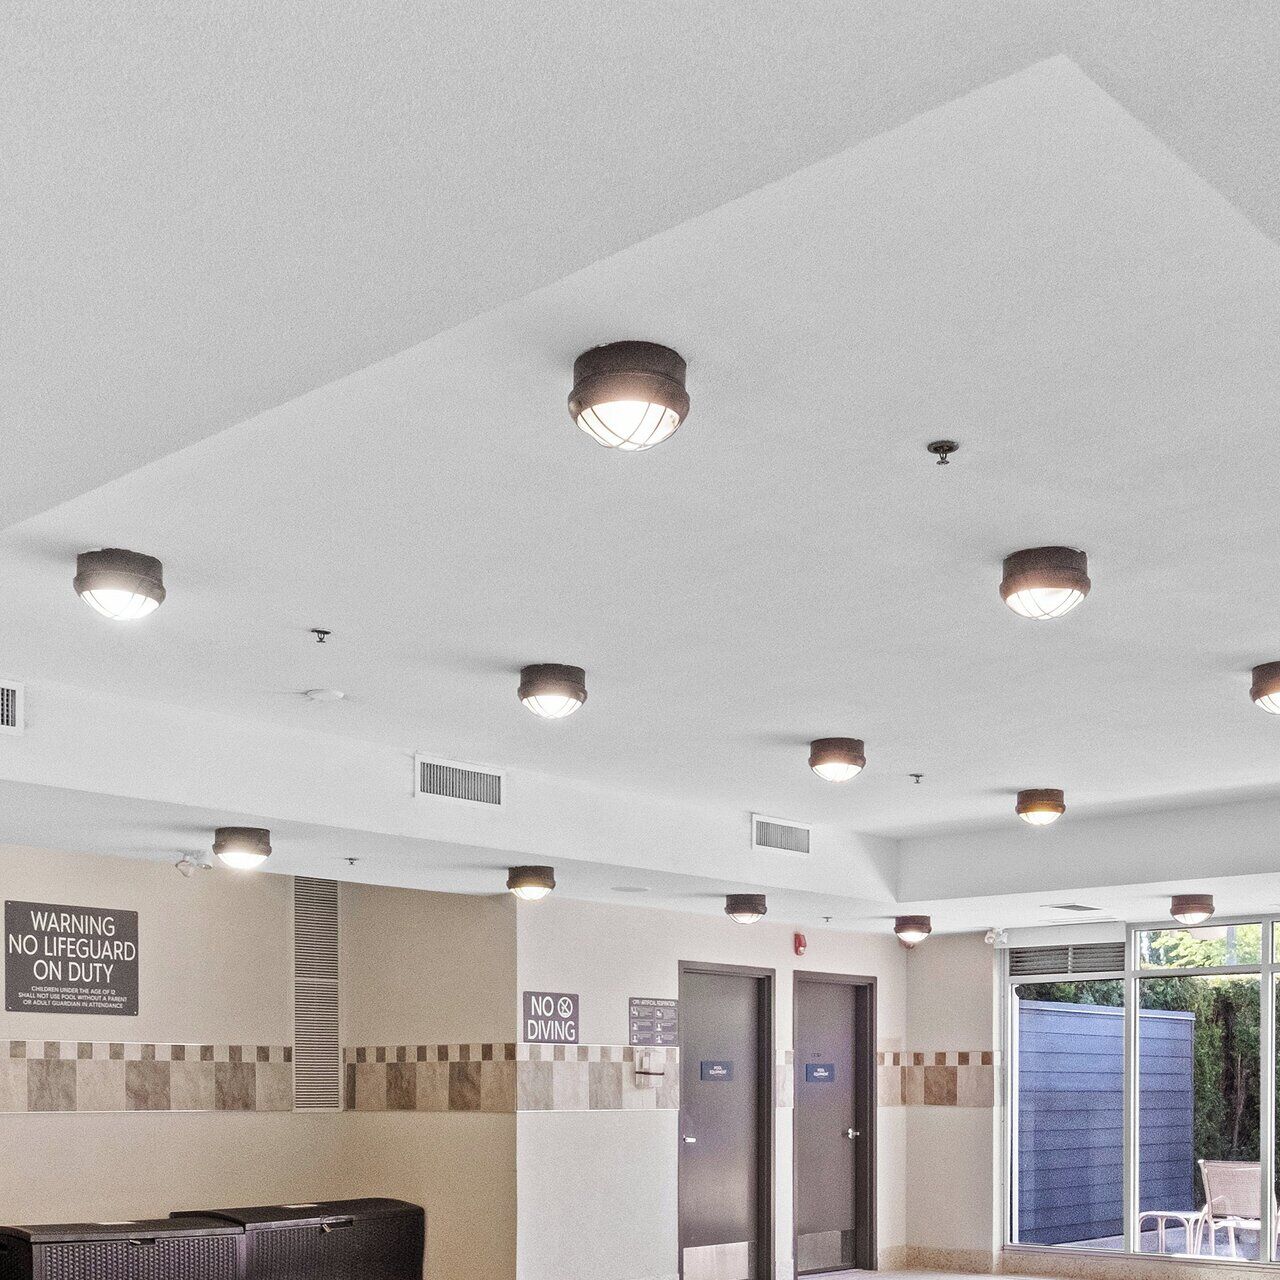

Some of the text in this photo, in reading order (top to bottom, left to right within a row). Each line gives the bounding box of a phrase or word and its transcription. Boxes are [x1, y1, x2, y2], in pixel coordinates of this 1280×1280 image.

[30, 911, 115, 936] WARNING
[9, 934, 136, 960] NO LIFEGUARD
[34, 960, 114, 982] ON DUTY
[531, 996, 554, 1016] NO
[528, 1020, 576, 1040] DIVING
